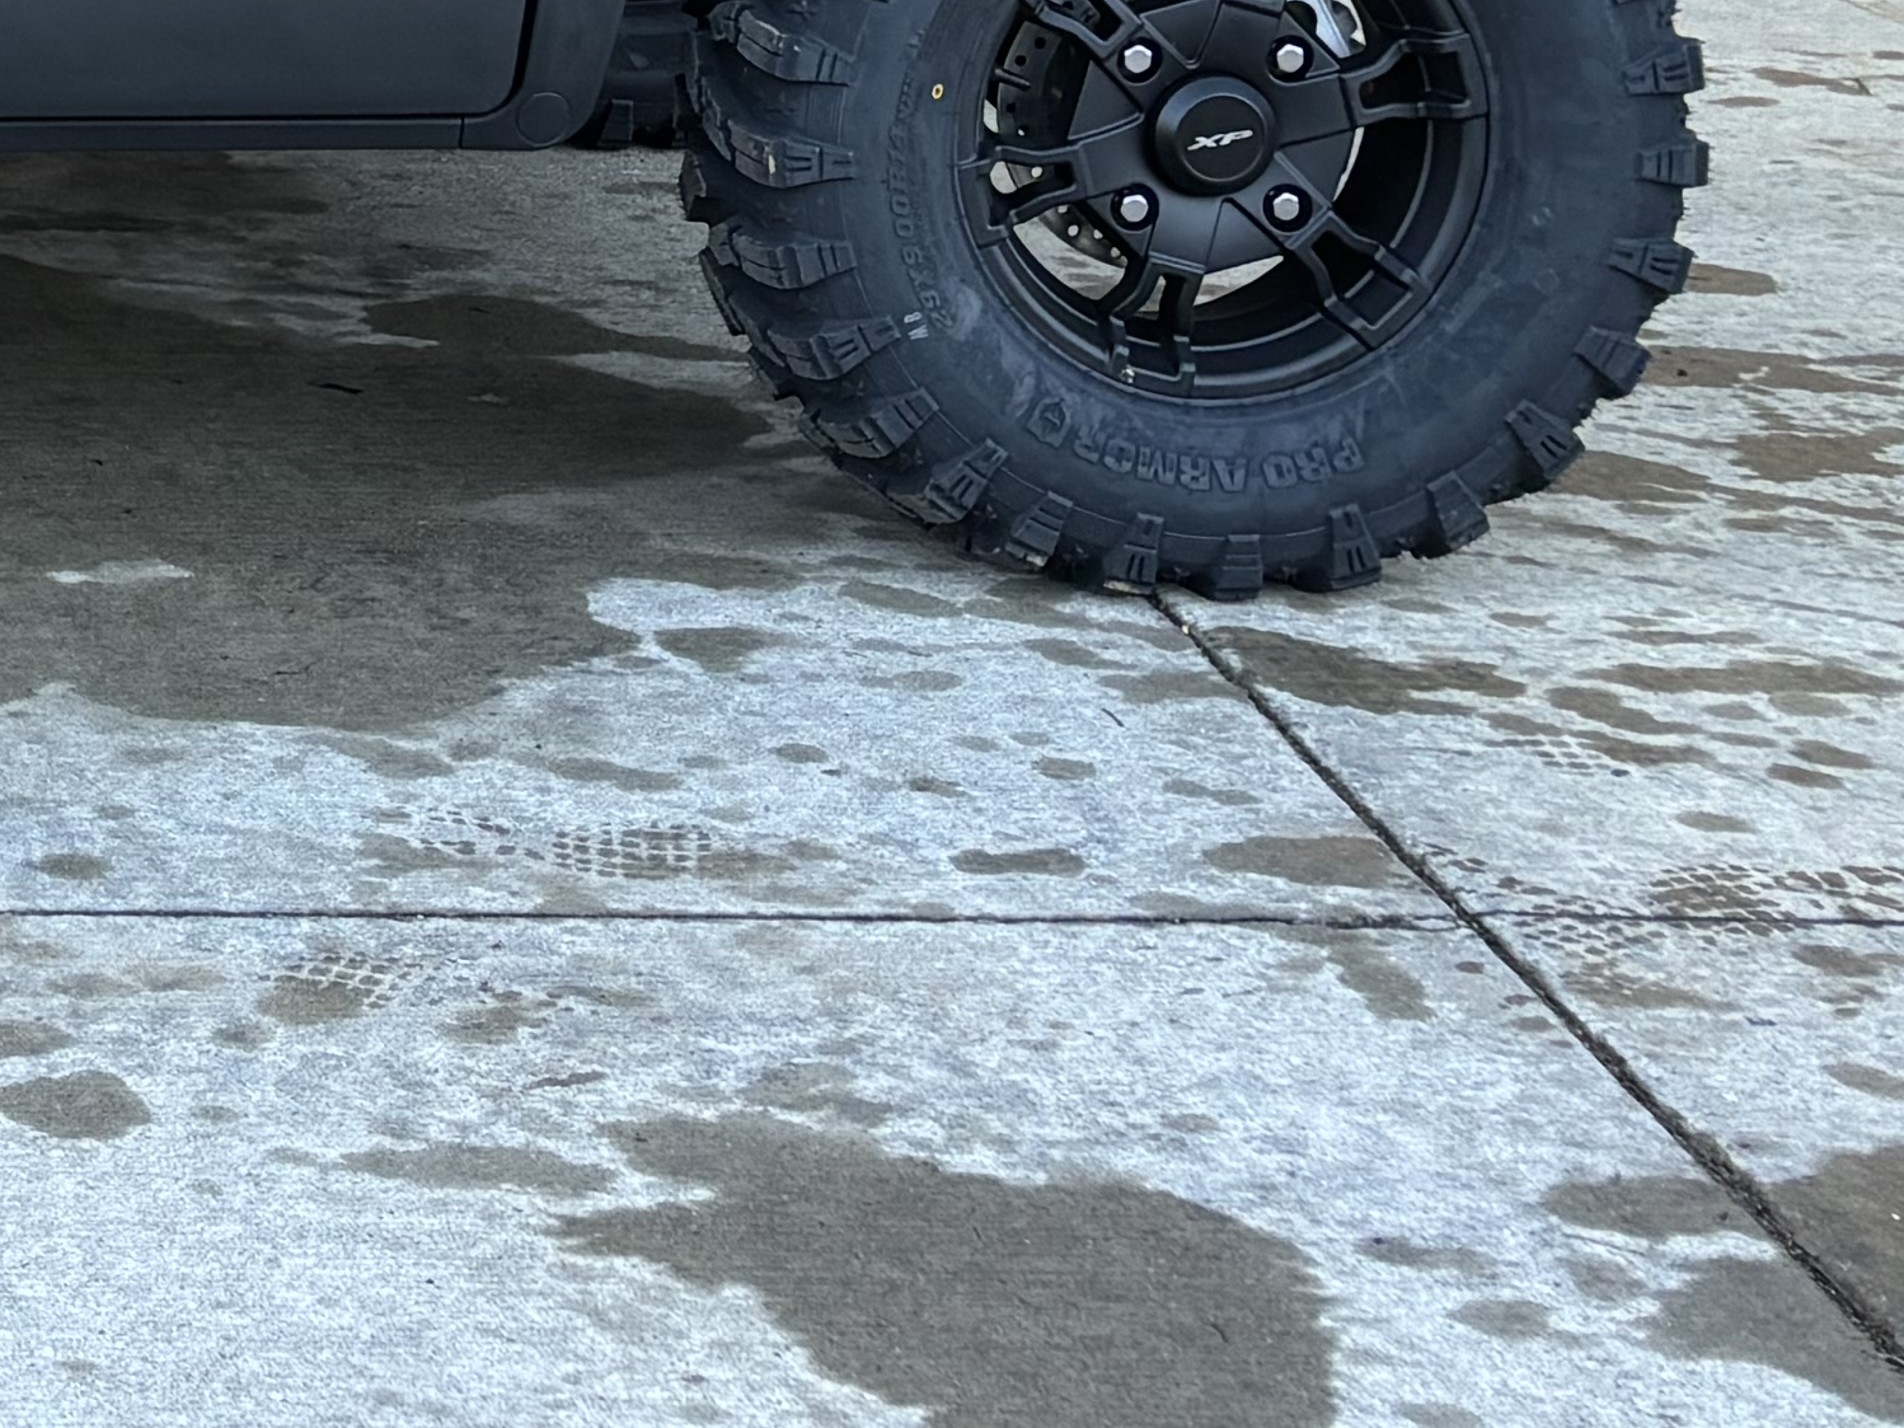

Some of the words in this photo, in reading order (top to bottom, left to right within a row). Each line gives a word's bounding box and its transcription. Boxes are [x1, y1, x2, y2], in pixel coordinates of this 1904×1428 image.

[1187, 129, 1254, 151] XP
[1072, 425, 1248, 492] ARMOR
[1261, 436, 1366, 490] PRO
